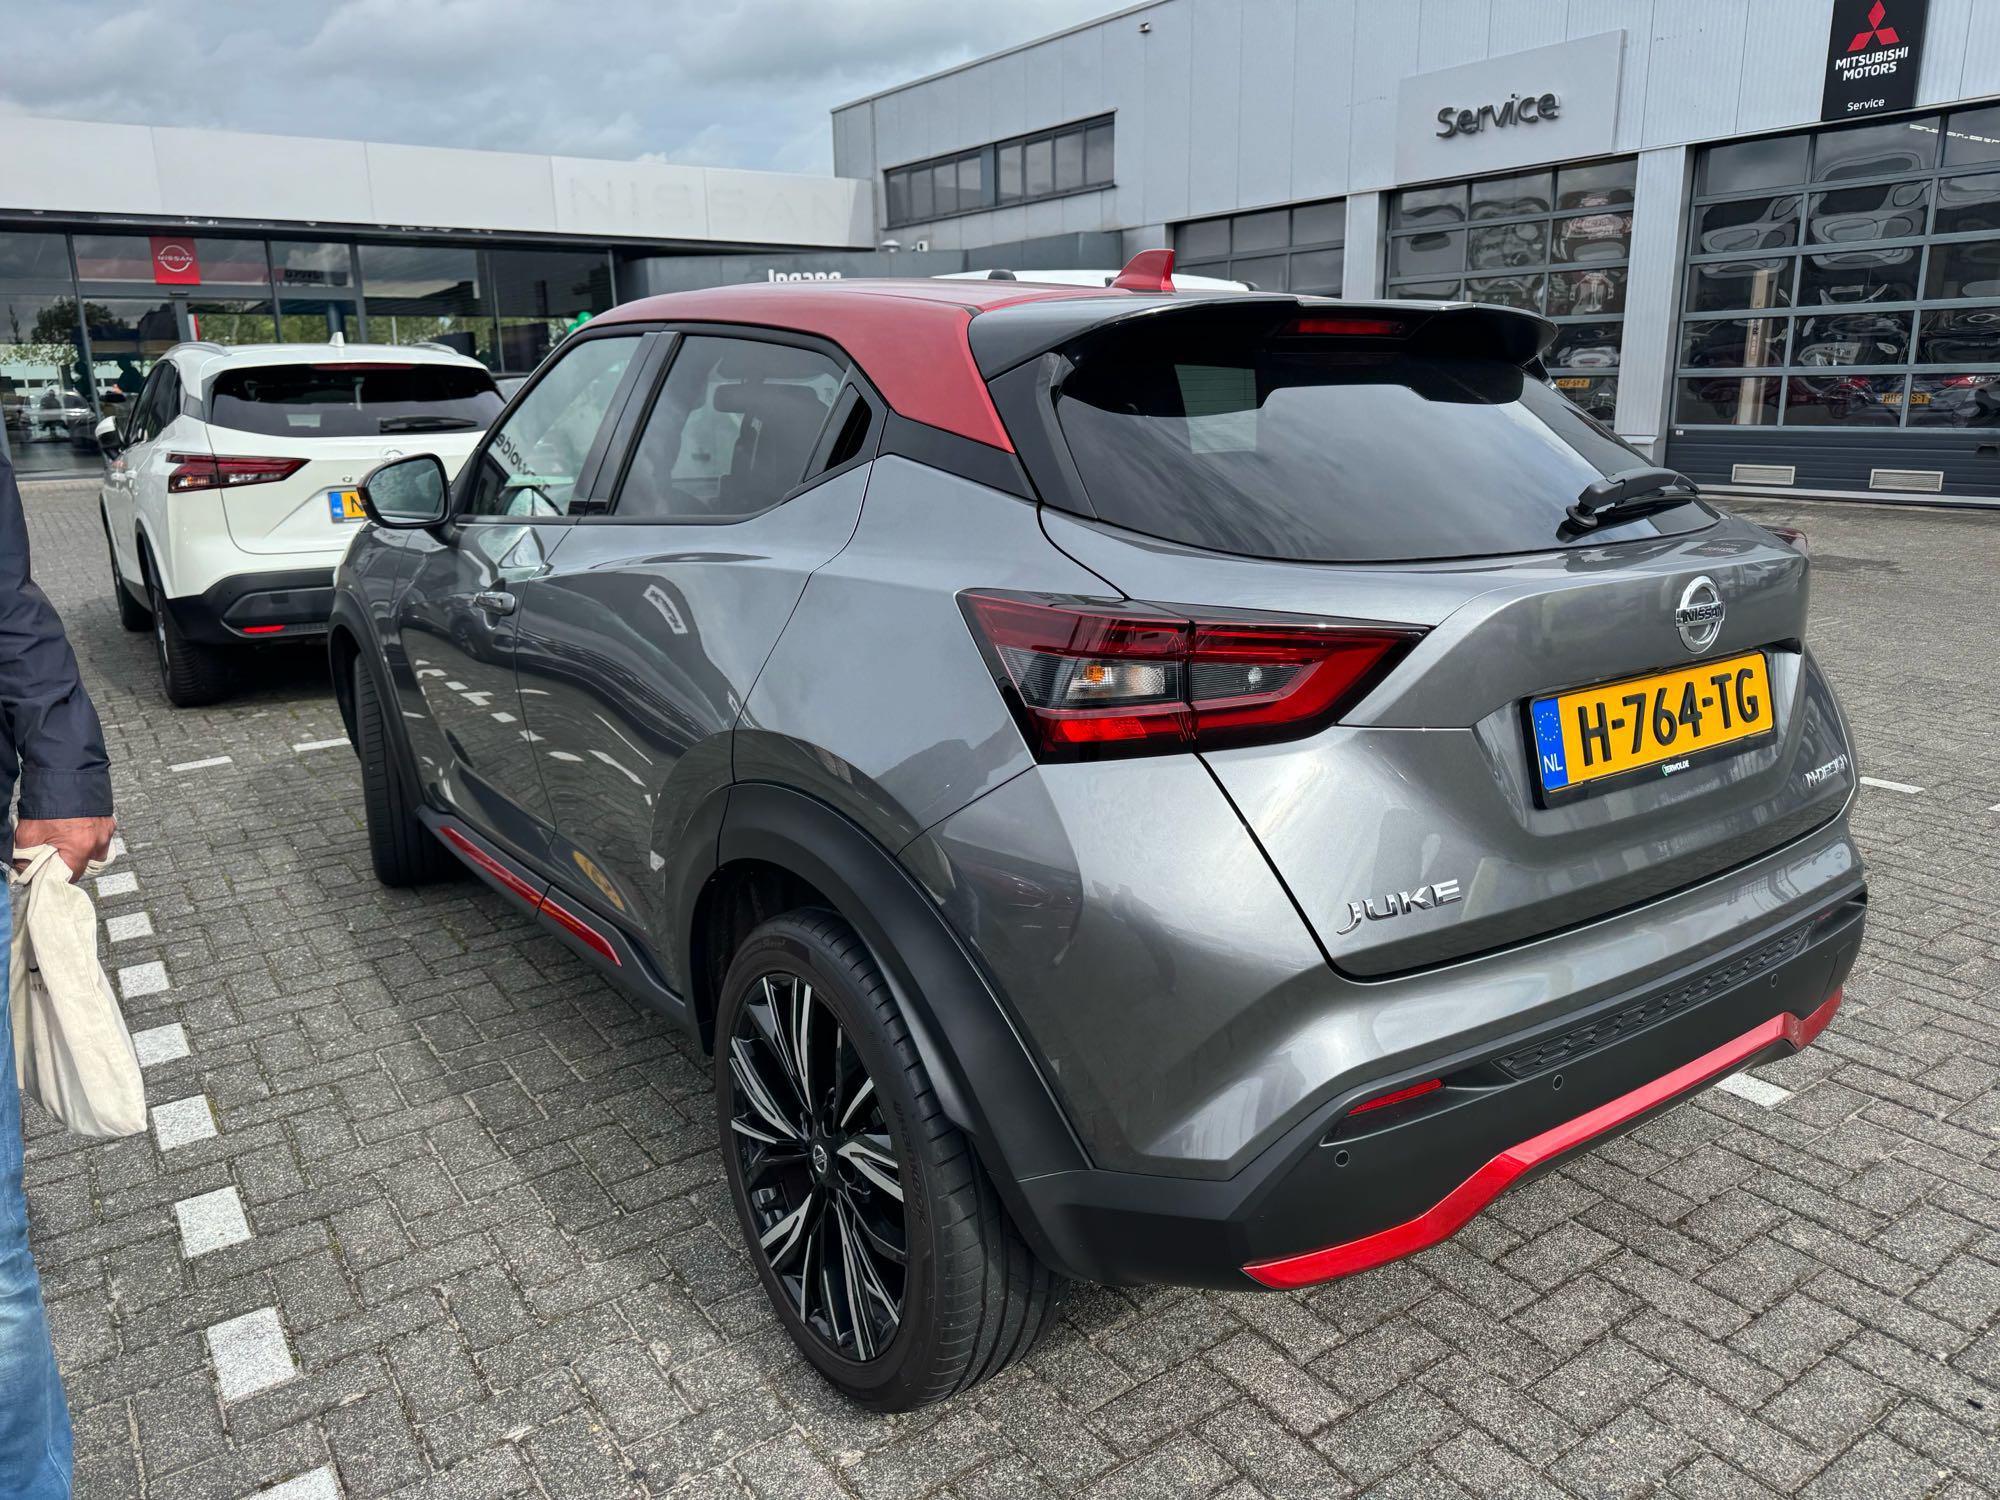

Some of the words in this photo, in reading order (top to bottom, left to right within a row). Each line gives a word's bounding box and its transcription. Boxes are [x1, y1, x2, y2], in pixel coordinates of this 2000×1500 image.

[1835, 46, 1909, 71] MITSUBISHI
[1843, 61, 1897, 81] MOTORS
[1436, 93, 1561, 138] Service
[1847, 98, 1886, 112] Service
[1682, 604, 1723, 623] NISSAN
[1577, 668, 1760, 767] H-764-TG
[1543, 753, 1564, 774] NL
[1336, 879, 1462, 935] JUKE
